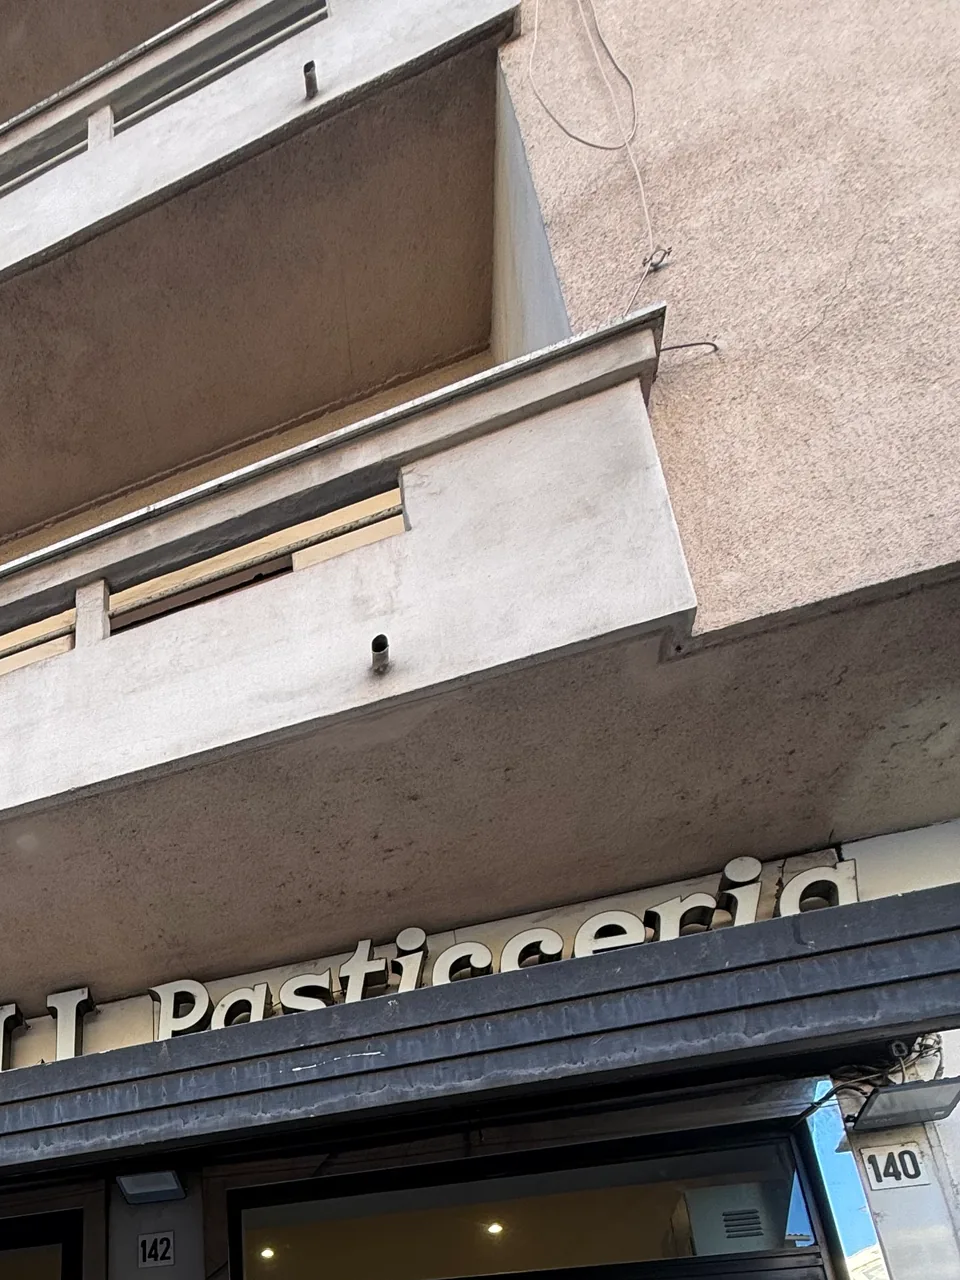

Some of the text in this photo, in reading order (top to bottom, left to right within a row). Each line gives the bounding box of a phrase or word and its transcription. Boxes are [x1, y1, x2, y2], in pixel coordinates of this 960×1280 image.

[149, 856, 859, 1042] Pasticceria
[867, 1149, 921, 1184] 140
[141, 1237, 171, 1262] 142
